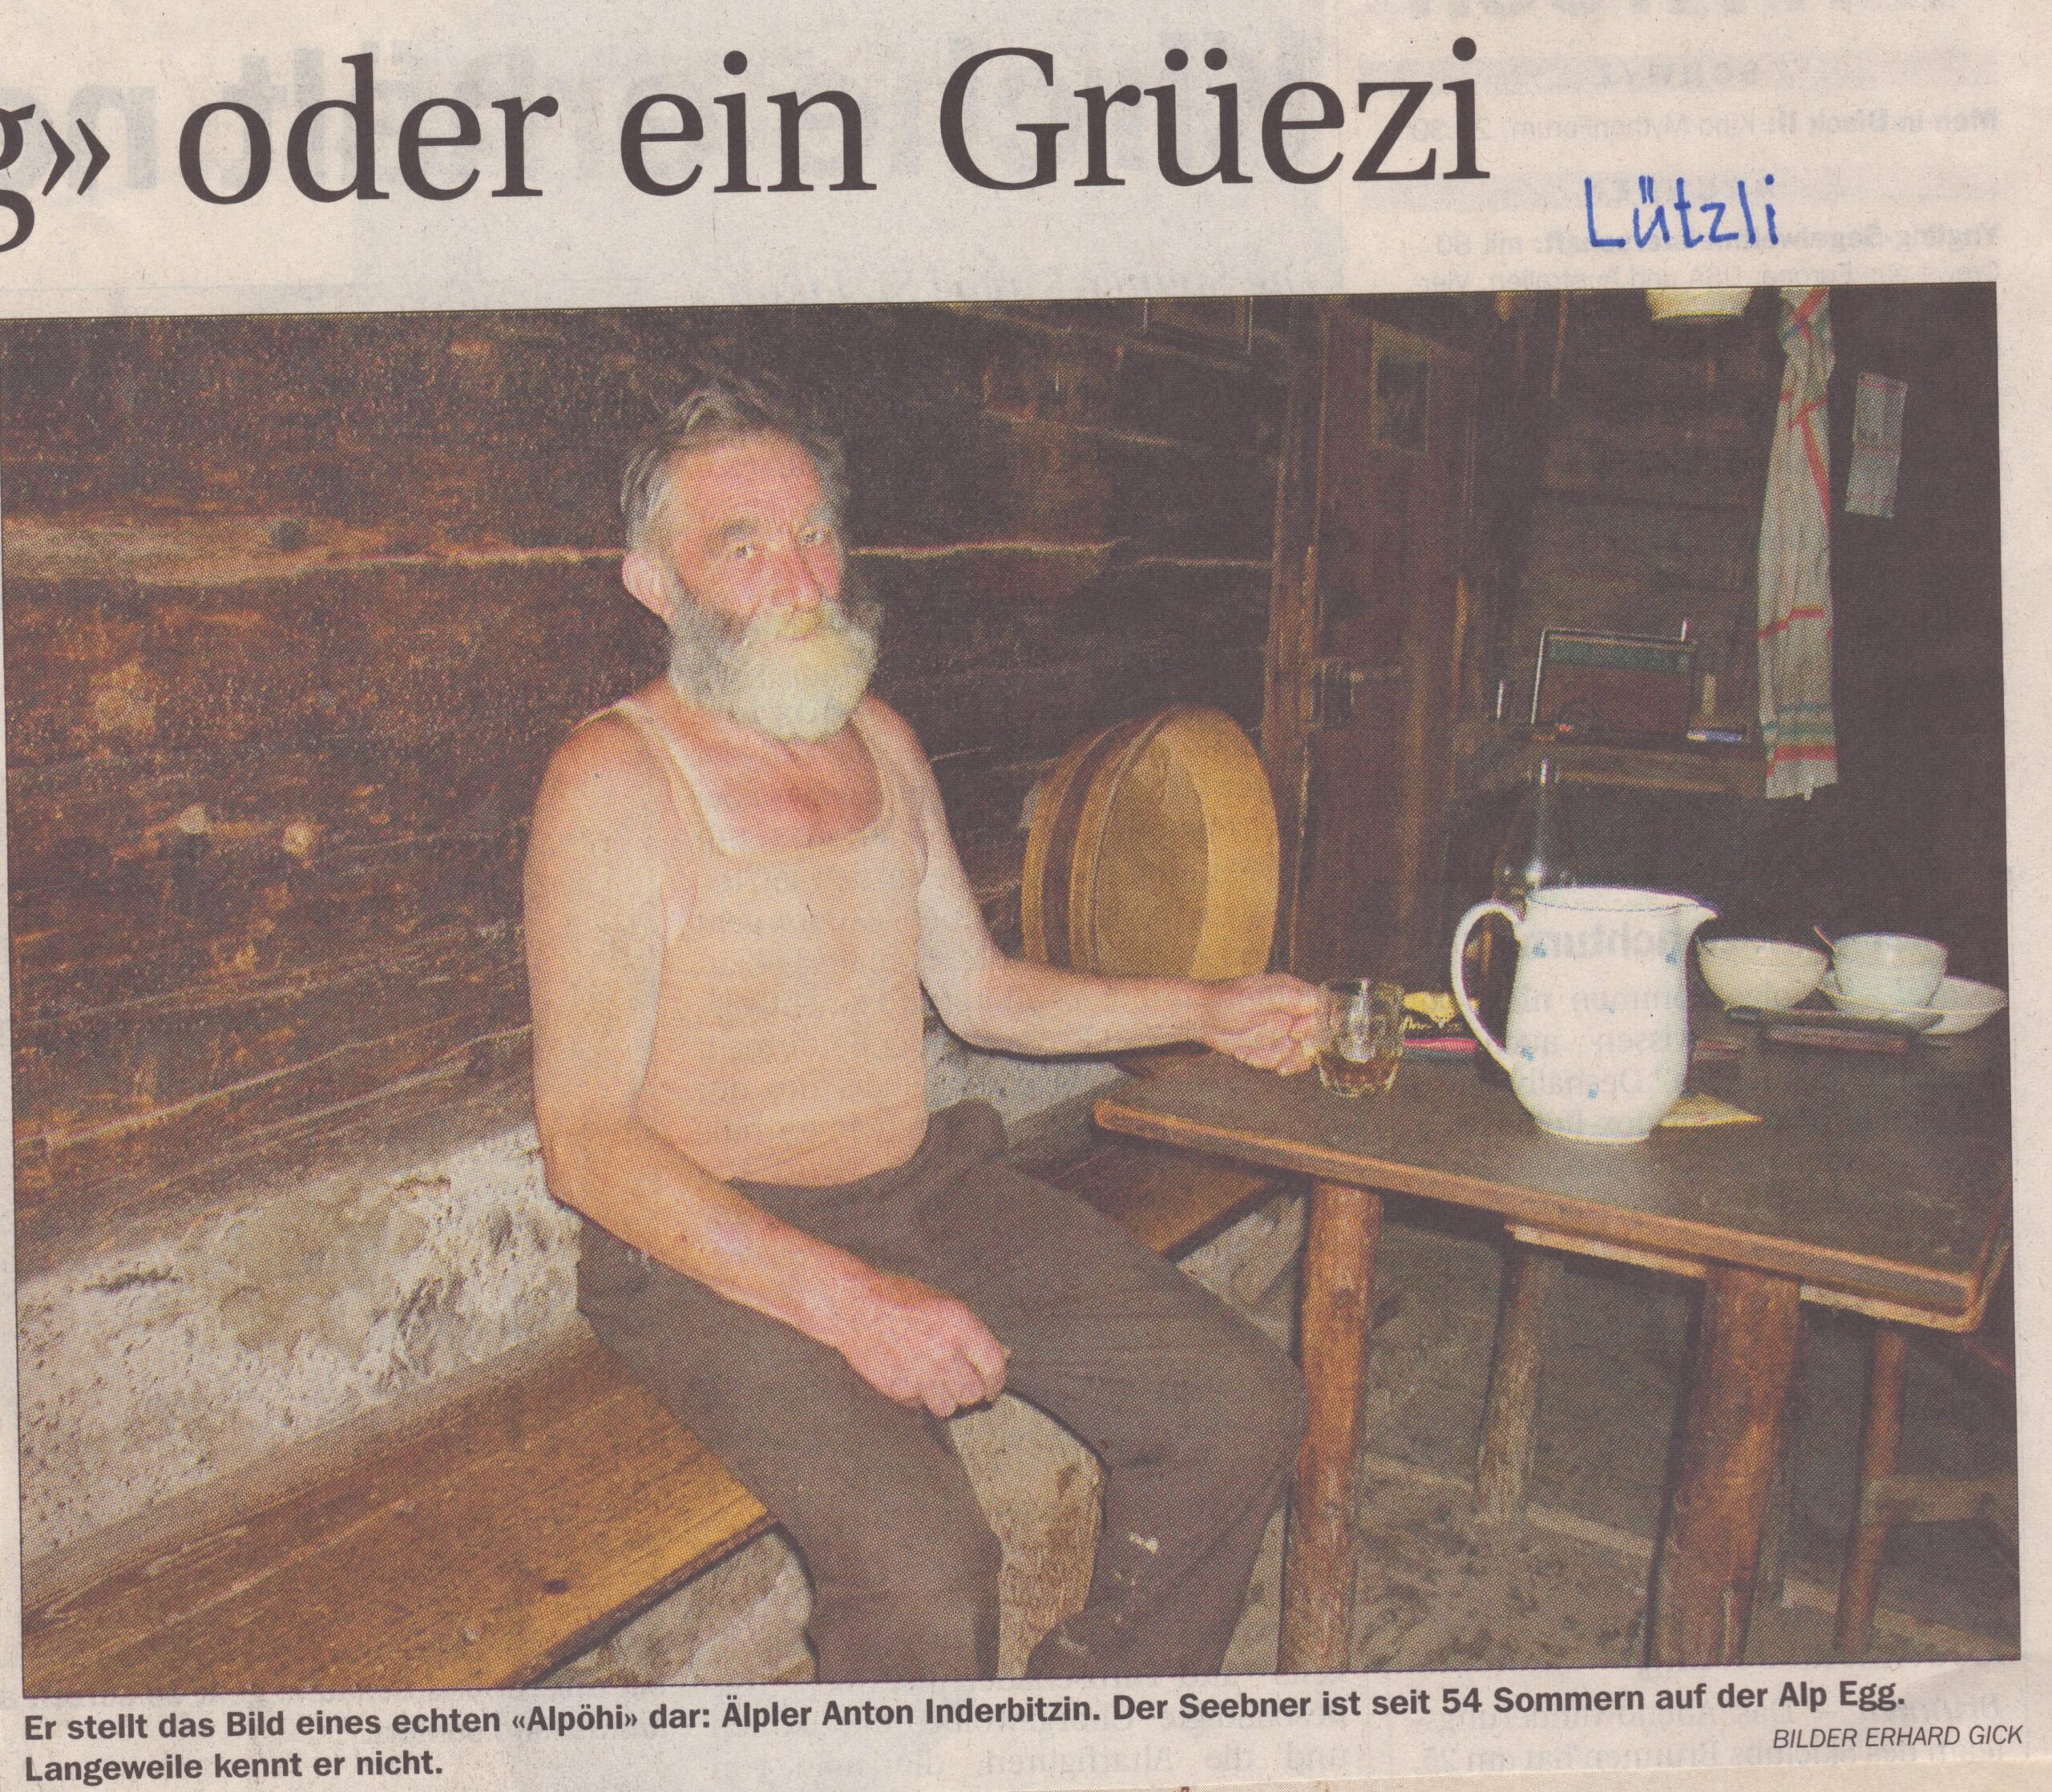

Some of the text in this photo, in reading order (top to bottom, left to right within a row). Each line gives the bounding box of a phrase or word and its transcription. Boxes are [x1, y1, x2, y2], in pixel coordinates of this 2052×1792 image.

[179, 53, 559, 205] oder
[620, 50, 877, 197] ein
[939, 37, 1491, 191] Grüezi
[1585, 175, 1779, 248] Lützli
[25, 1680, 1905, 1741] Er stellt das Bild eines echten «Alpöhi» dar: Älpler Anton Inderbitzin. Der Seebner ist seit 54 Sommern auf der Alp Egg.
[1773, 1725, 2024, 1749] BILDER ERHARD GICK
[25, 1750, 442, 1787] Langeweile kennt er nicht.
